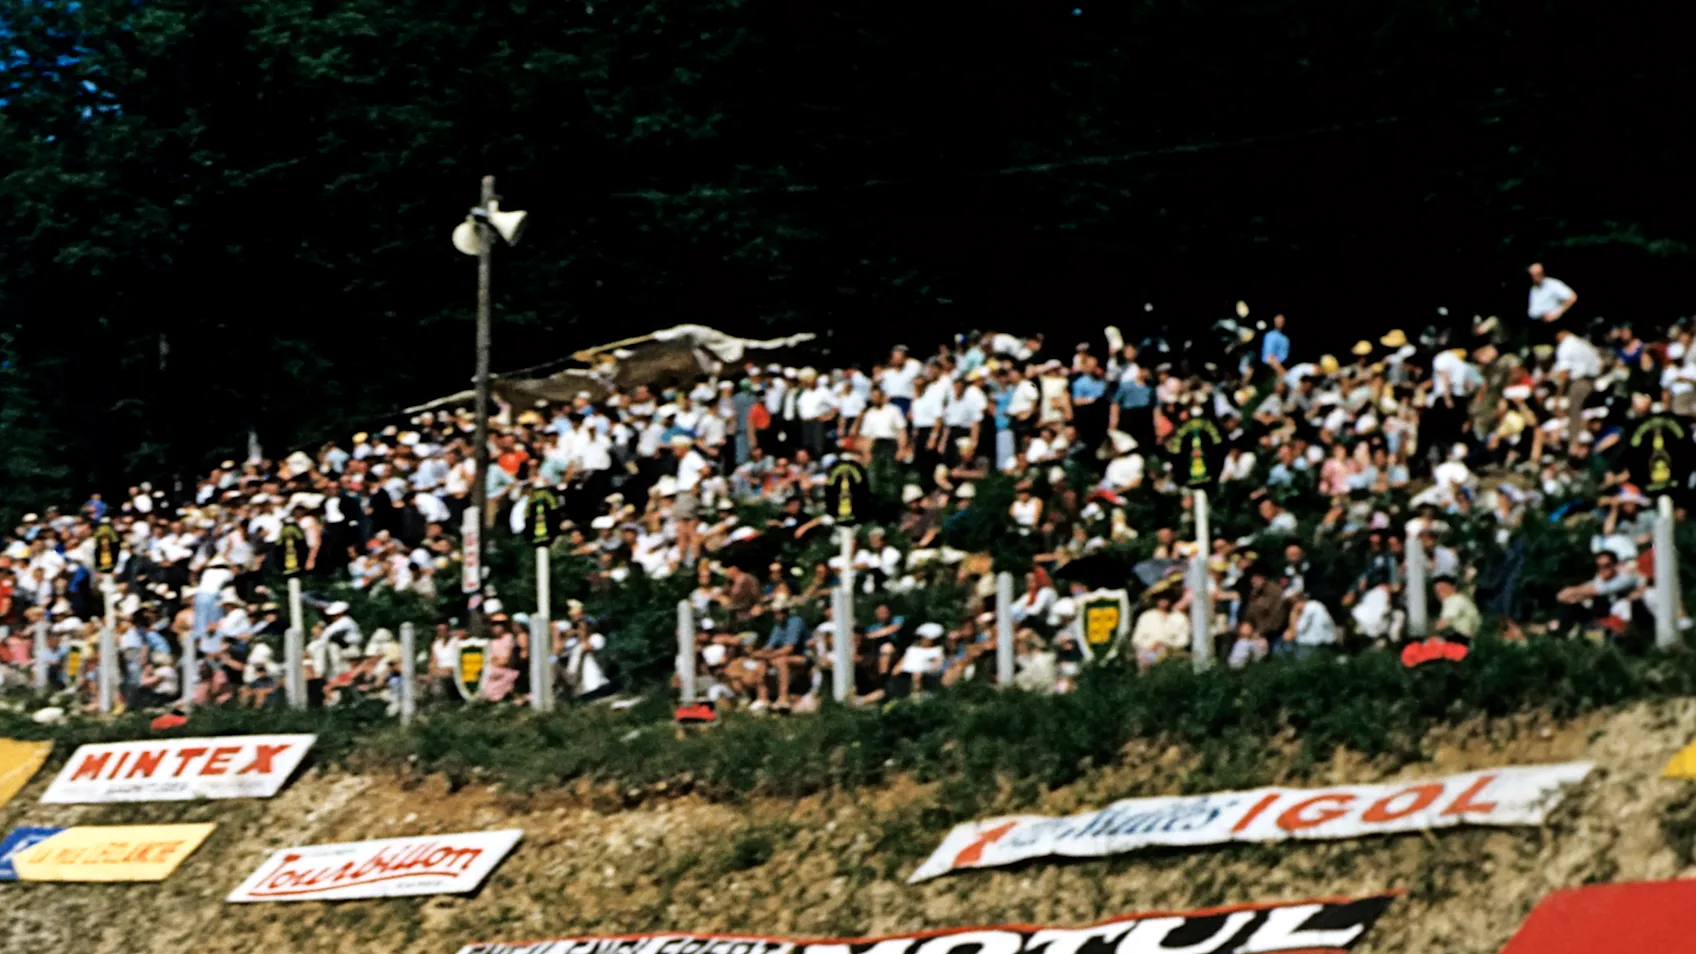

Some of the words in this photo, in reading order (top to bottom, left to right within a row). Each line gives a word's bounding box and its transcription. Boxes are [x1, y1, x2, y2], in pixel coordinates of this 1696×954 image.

[70, 744, 293, 782] MINTEX
[1232, 775, 1497, 832] IGOL
[255, 842, 485, 889] Tourbillon
